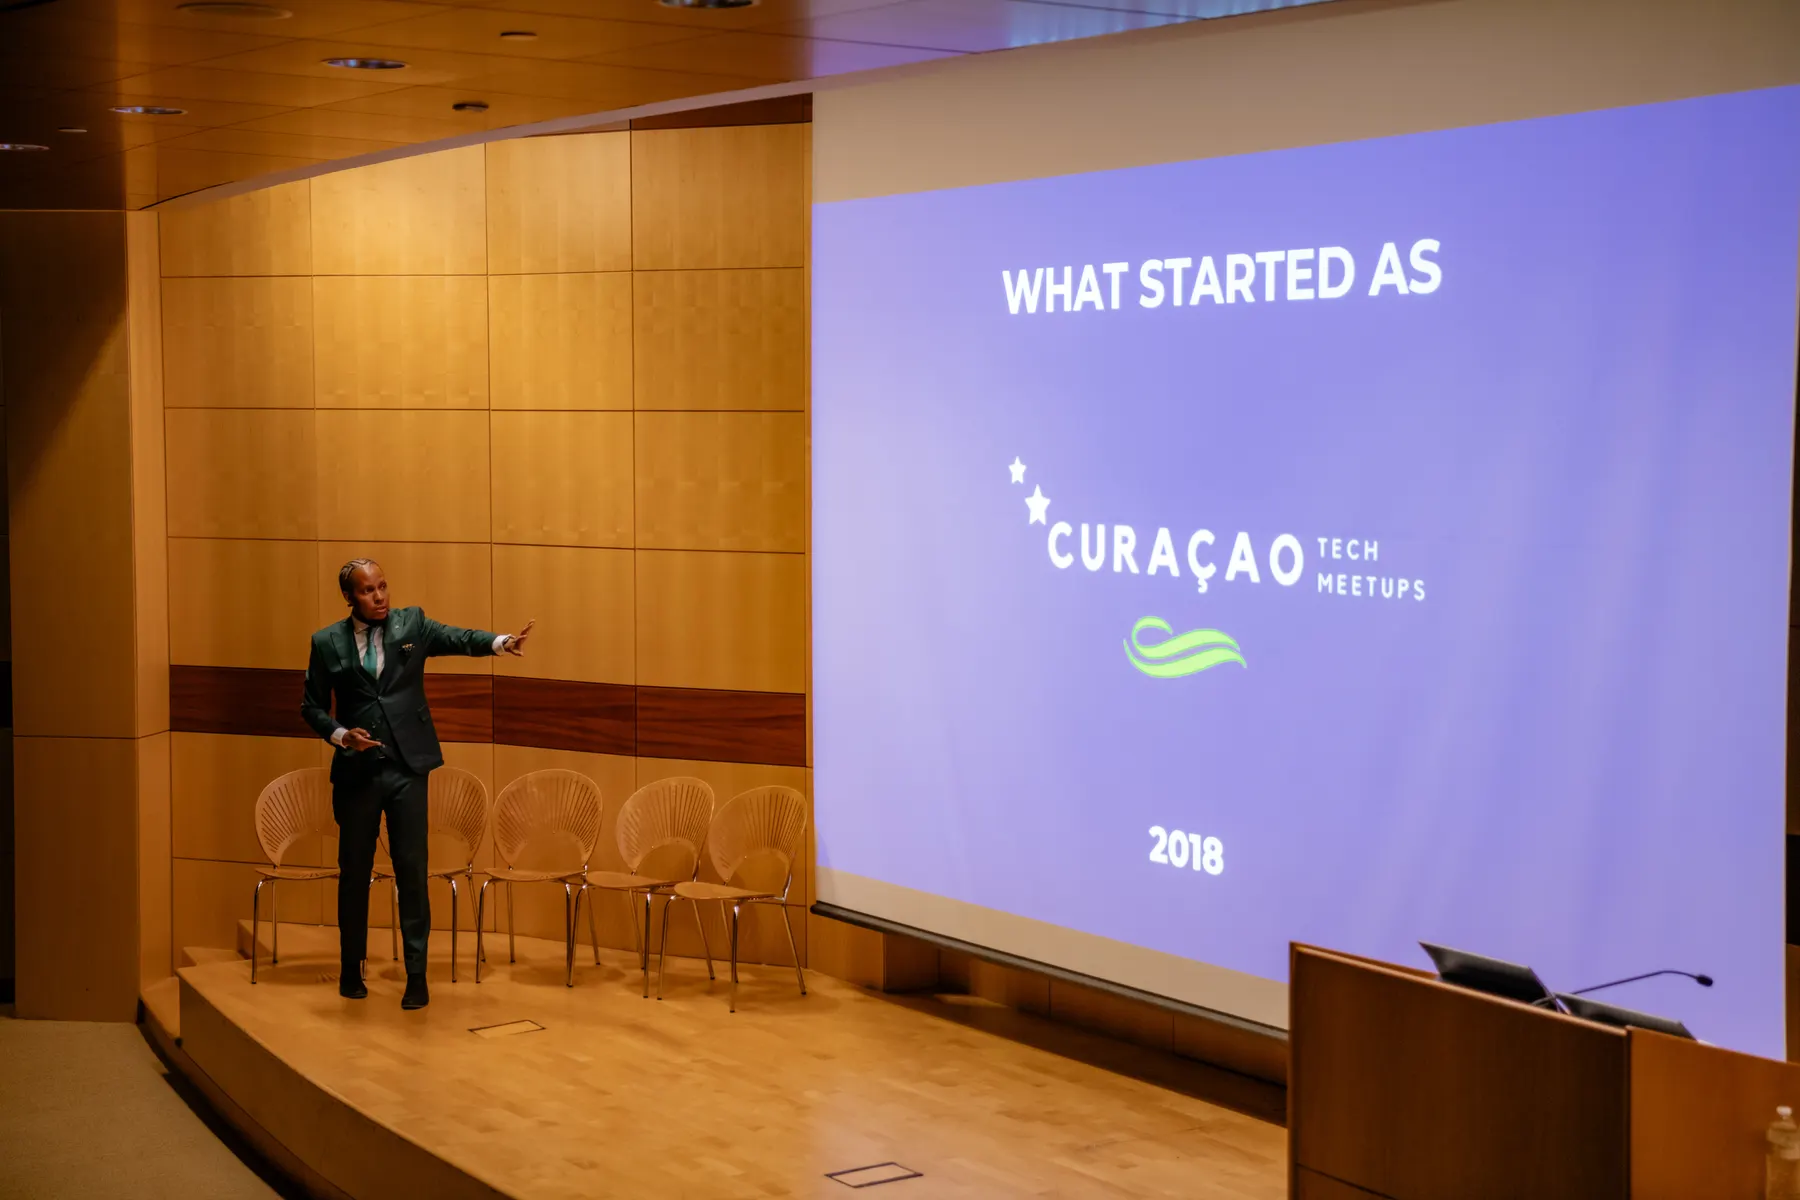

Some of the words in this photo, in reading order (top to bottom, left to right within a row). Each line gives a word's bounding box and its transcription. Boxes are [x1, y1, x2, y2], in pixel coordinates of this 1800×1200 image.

[1001, 262, 1130, 315] WHAT
[1138, 246, 1356, 309] STARTED
[1368, 238, 1443, 297] AS
[1047, 521, 1304, 594] CURAÇAO
[1317, 536, 1379, 562] TECH
[1317, 572, 1426, 602] MEETUPS
[1147, 825, 1225, 877] 2018
